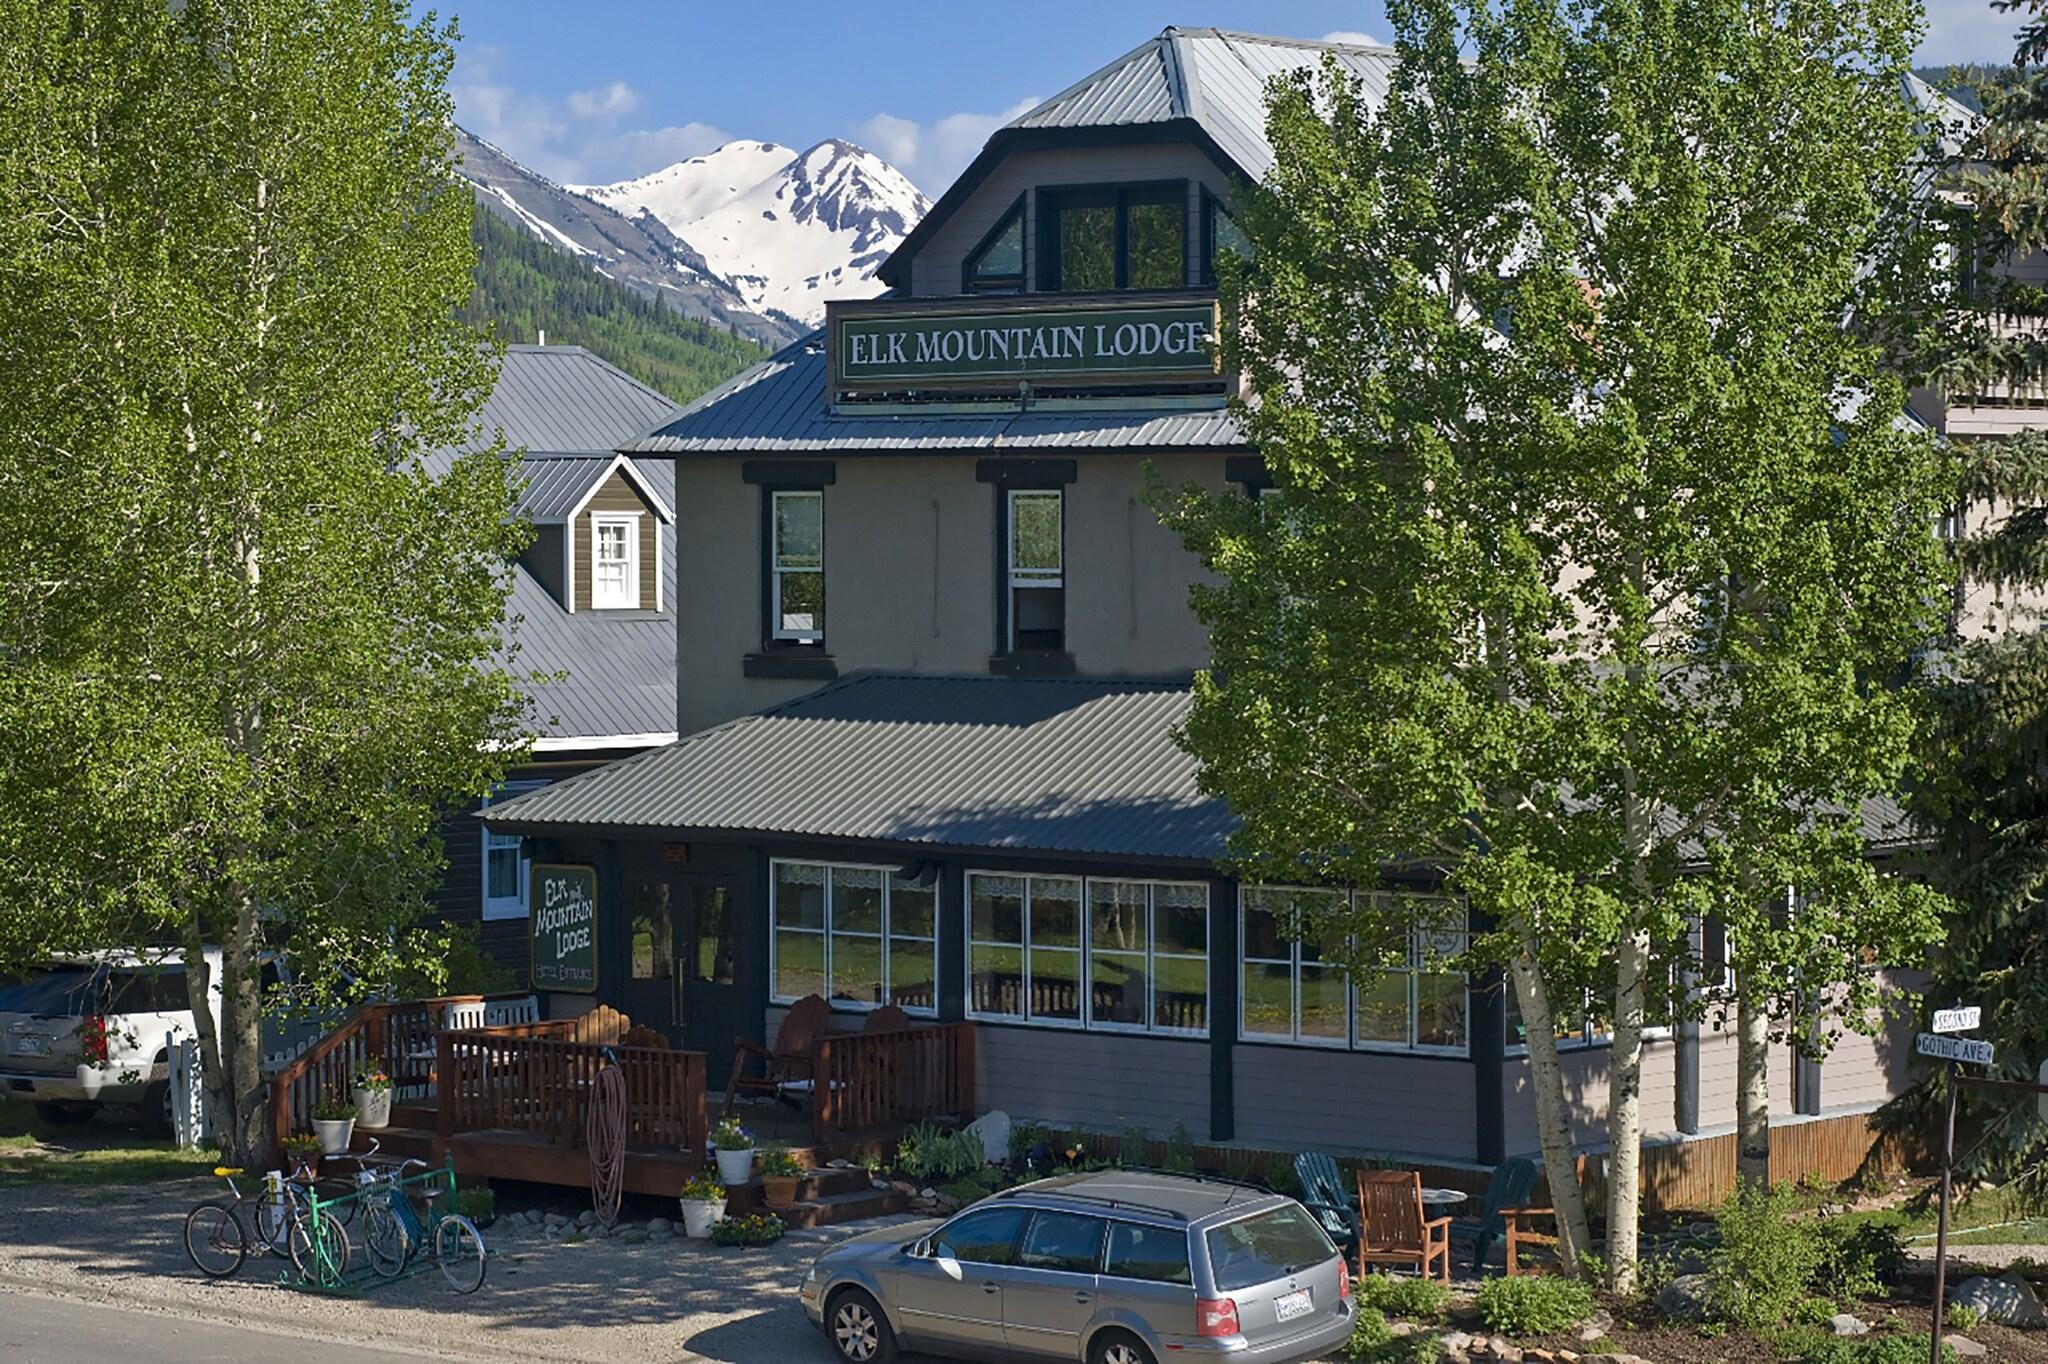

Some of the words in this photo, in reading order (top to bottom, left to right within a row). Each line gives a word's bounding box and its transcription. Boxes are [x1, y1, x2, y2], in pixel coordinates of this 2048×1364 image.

[849, 332, 908, 366] ELK
[915, 324, 1086, 363] MOUNTAIN
[1094, 320, 1206, 358] LODGE
[545, 878, 569, 907] ELK
[535, 899, 593, 938] MOUNTAIN
[556, 927, 591, 959] LODGE
[1922, 1036, 1959, 1057] GOTHIC
